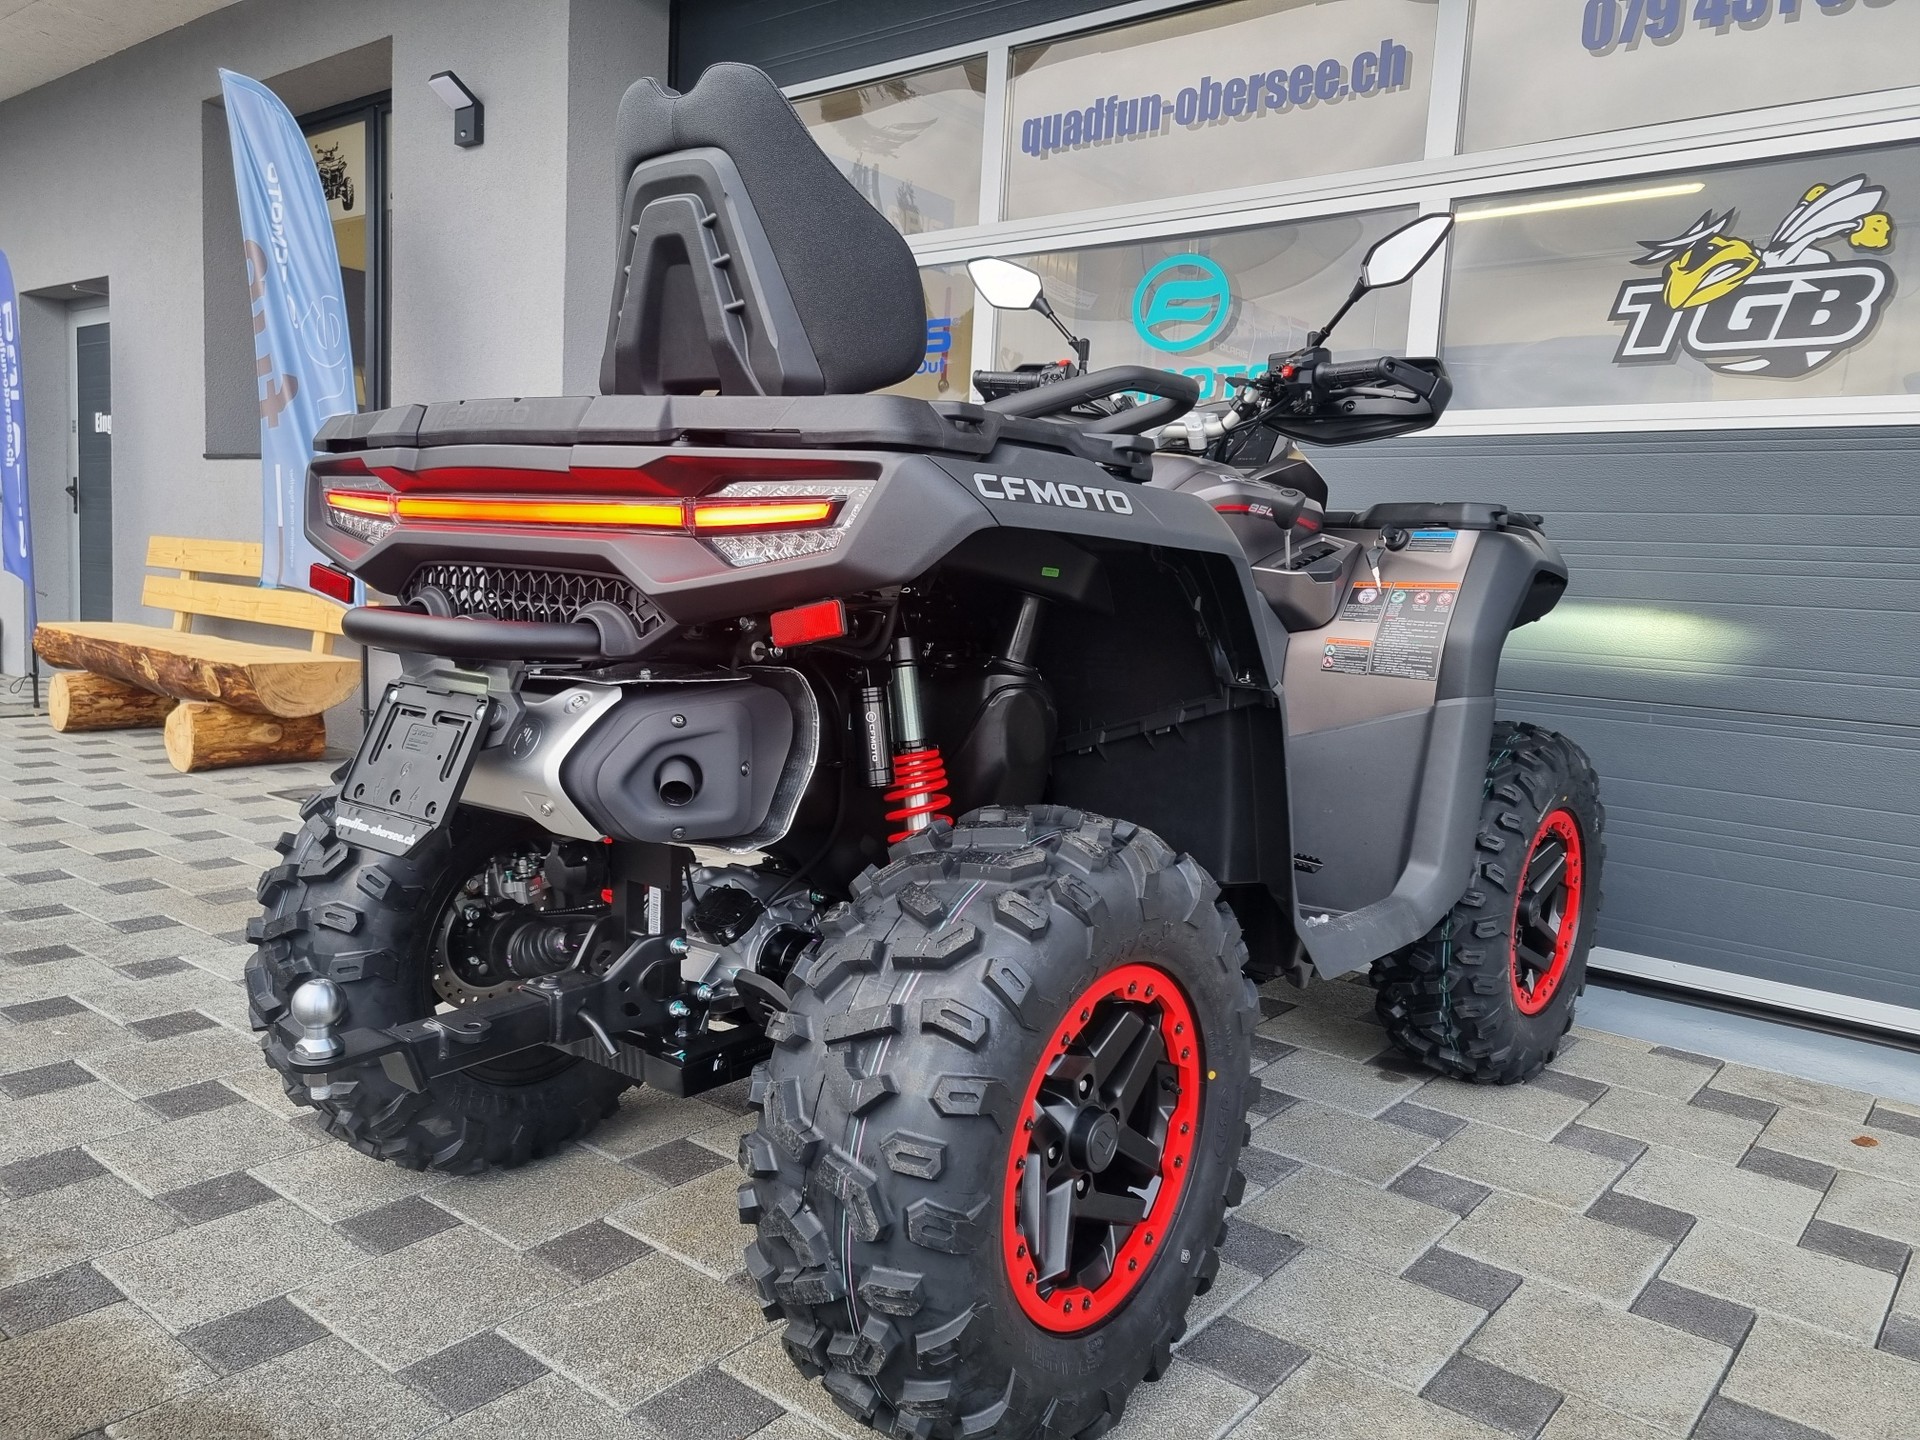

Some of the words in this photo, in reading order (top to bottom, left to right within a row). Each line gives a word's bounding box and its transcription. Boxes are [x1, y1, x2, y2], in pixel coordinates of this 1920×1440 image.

[1021, 39, 1410, 158] quadfun-obersee.ch
[1612, 262, 1891, 358] TGB
[973, 472, 1134, 516] CFMOTO
[870, 724, 878, 762] CFMOTO
